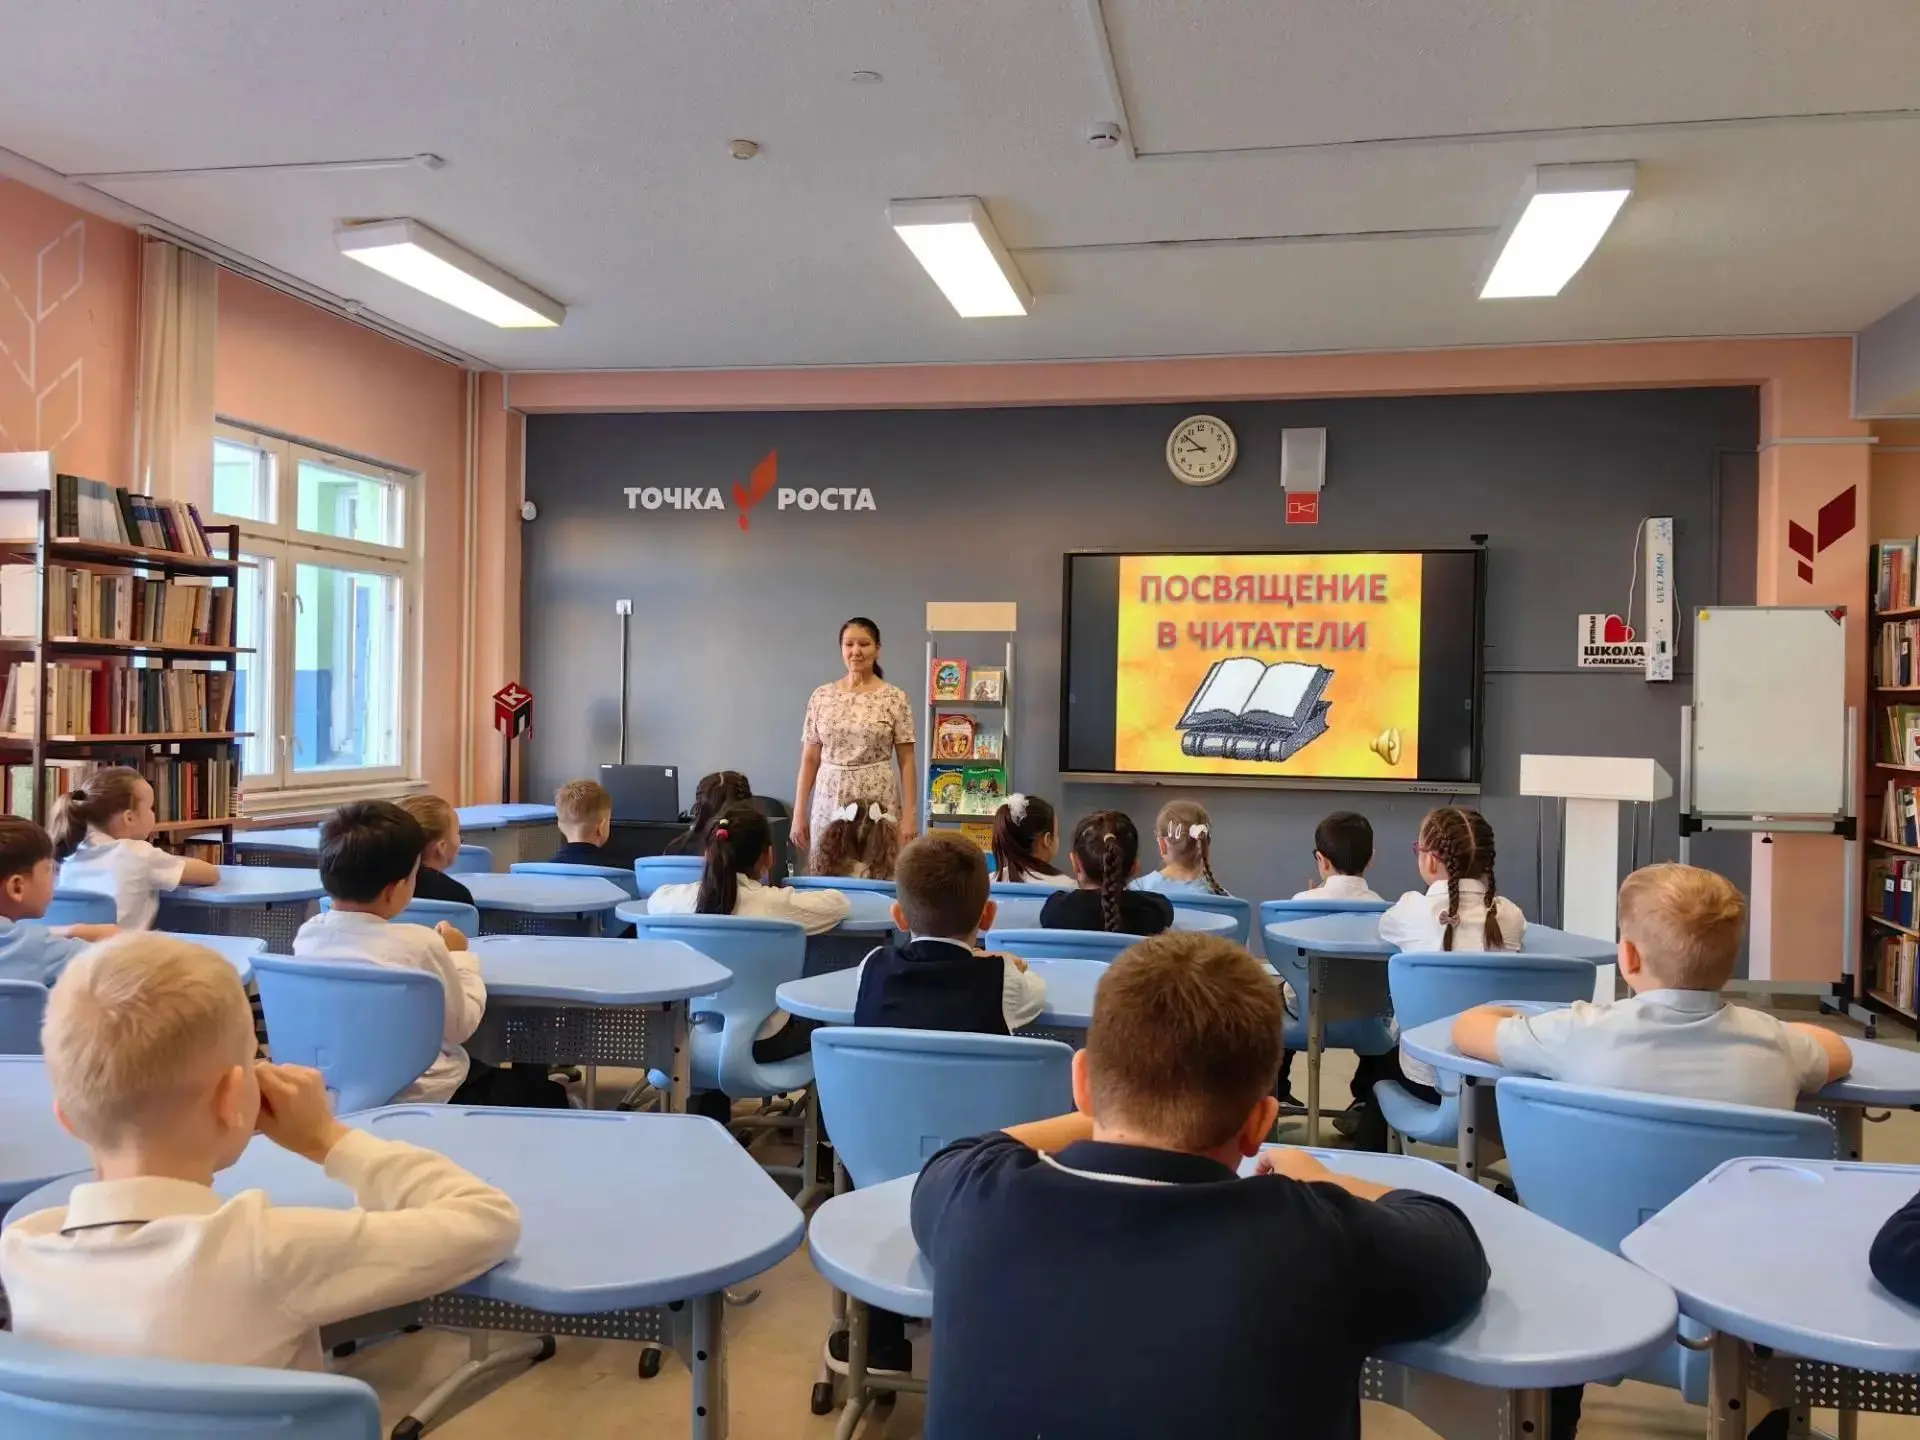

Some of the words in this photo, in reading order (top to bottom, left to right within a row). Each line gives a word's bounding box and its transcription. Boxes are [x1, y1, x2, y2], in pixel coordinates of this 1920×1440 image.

[1197, 424, 1205, 432] 12
[623, 487, 725, 510] ТОЧКА
[777, 487, 877, 511] РОСТА
[1140, 574, 1388, 608] ПОСВЯЩЕНИЕ
[1157, 621, 1177, 649] В
[1188, 621, 1367, 650] ЧИТАТЕЛИ
[1584, 646, 1645, 656] ШКОЛА
